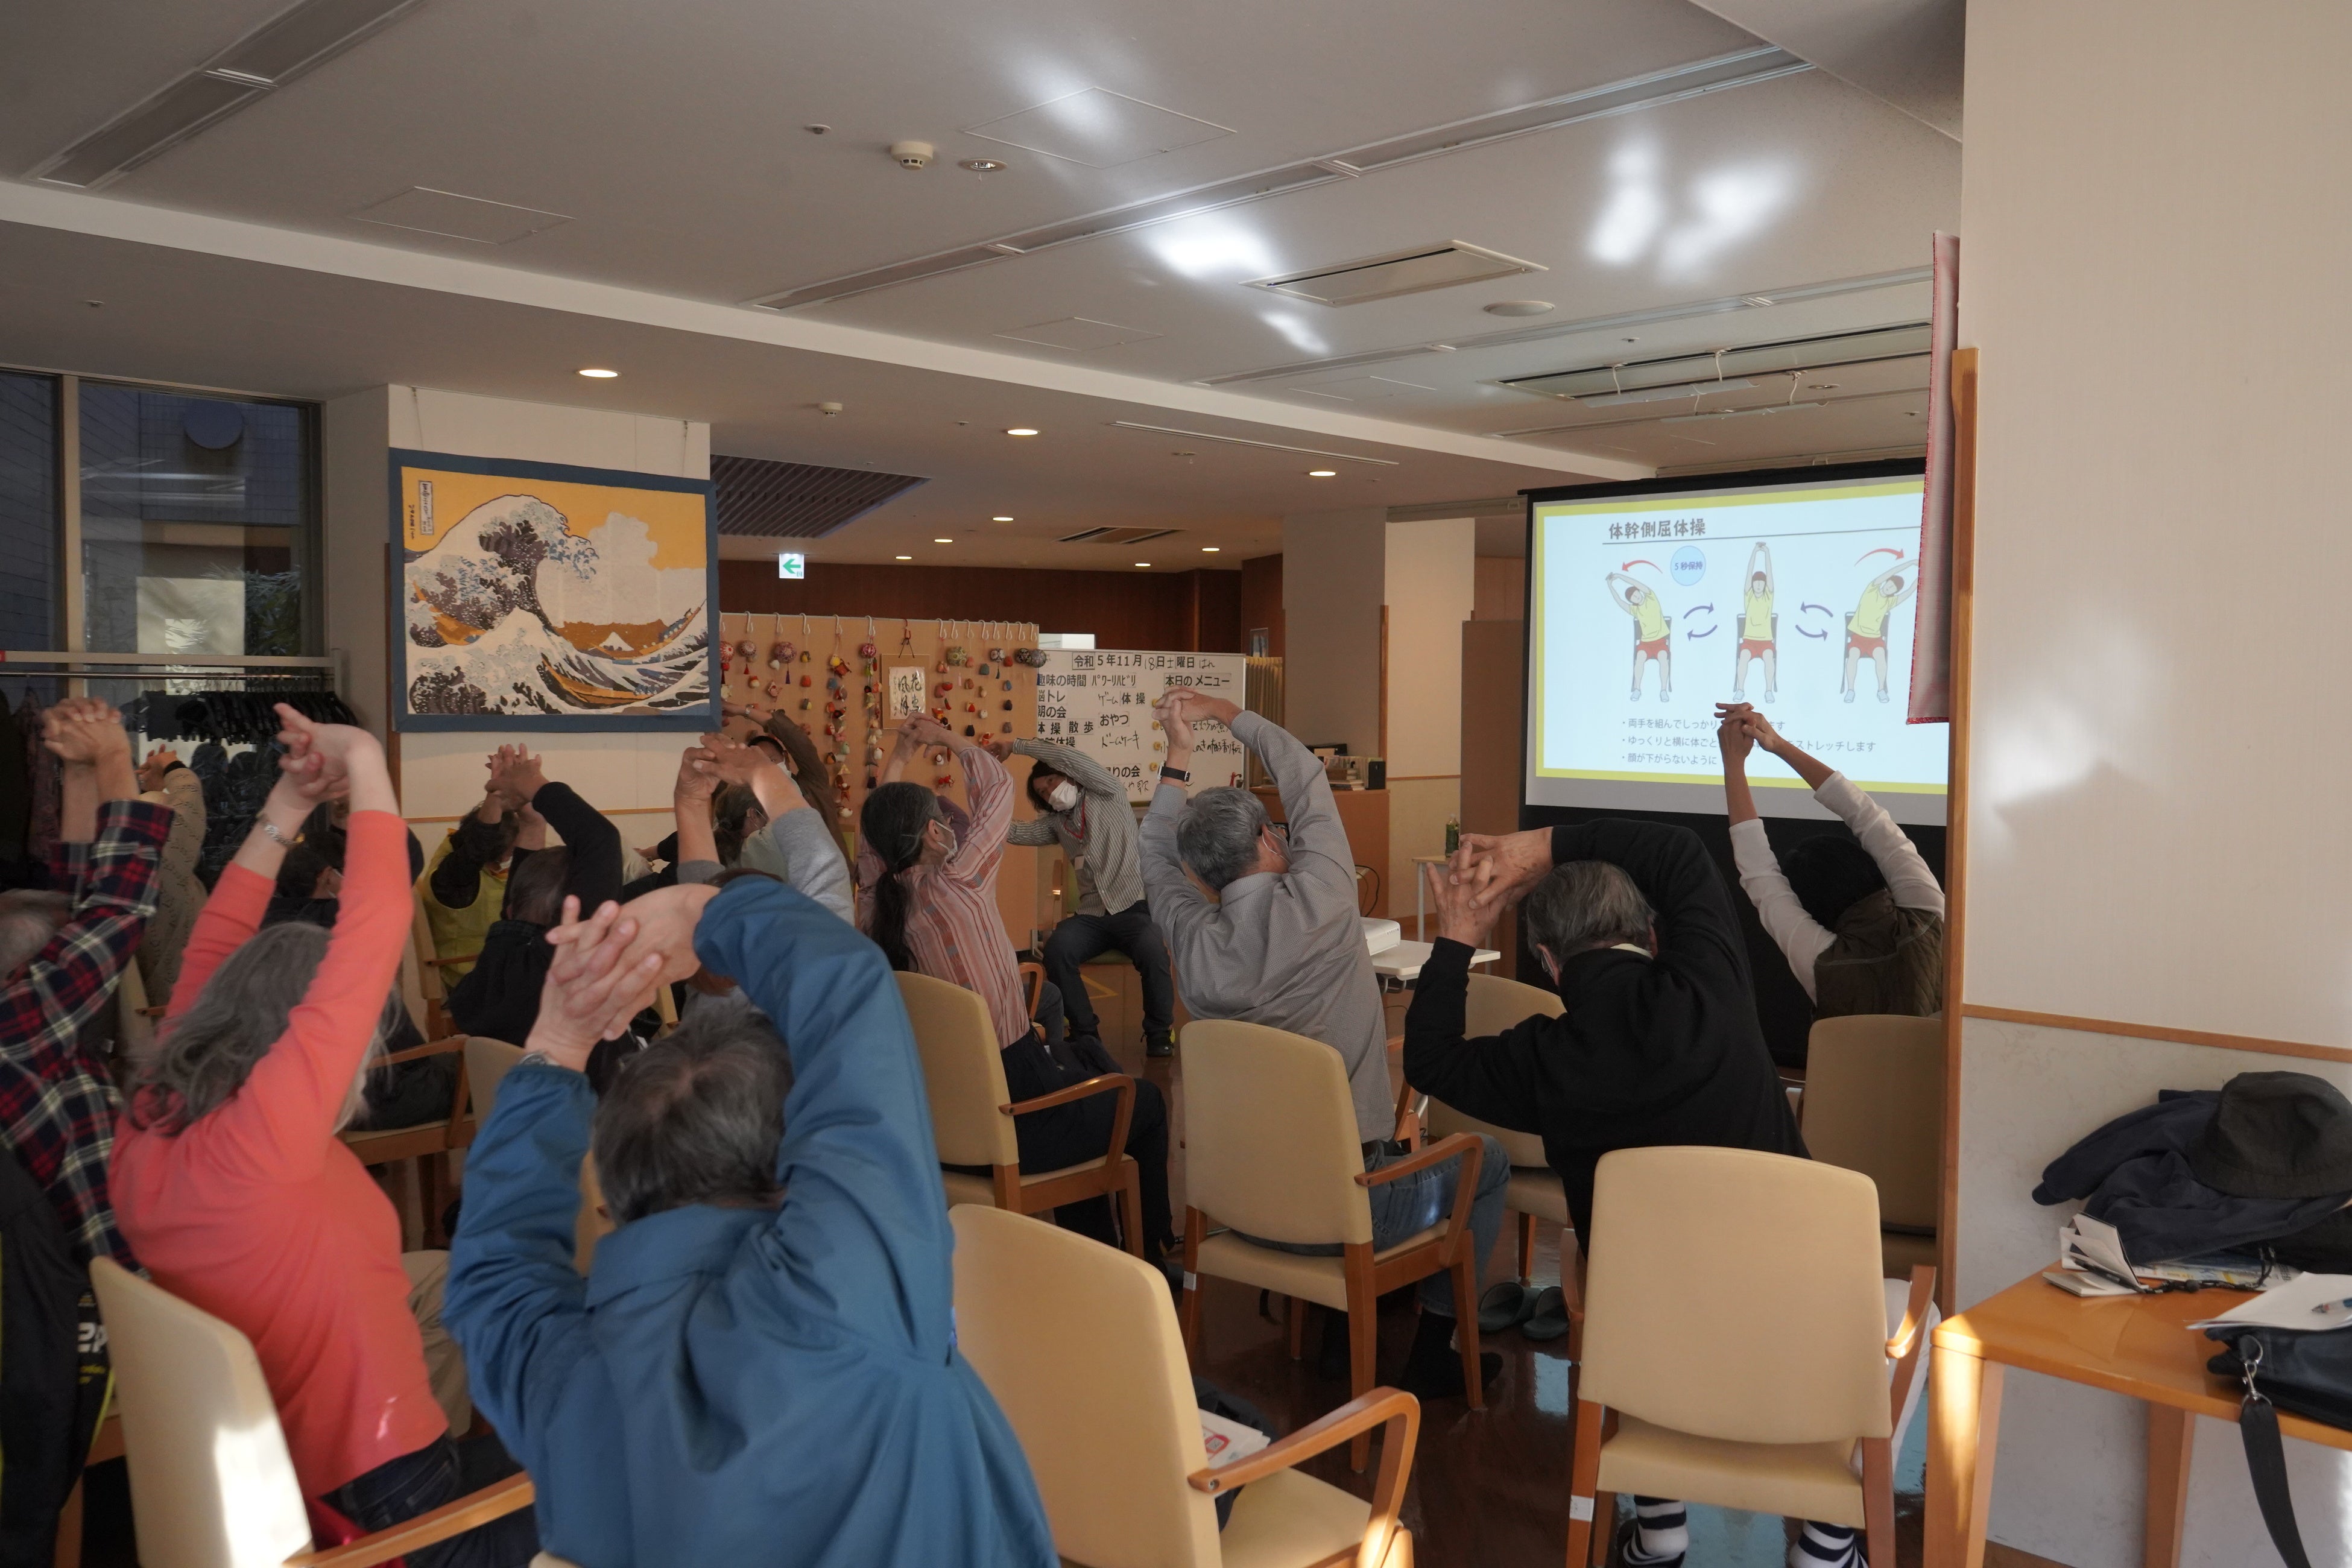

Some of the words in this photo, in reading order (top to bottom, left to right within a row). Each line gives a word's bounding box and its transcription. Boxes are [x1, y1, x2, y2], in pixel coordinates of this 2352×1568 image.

[1609, 518, 1706, 540] 体幹側屈体操
[1165, 675, 1230, 686] 本日のメニュー
[1100, 714, 1128, 727] おやつ
[1105, 765, 1140, 777] りの会
